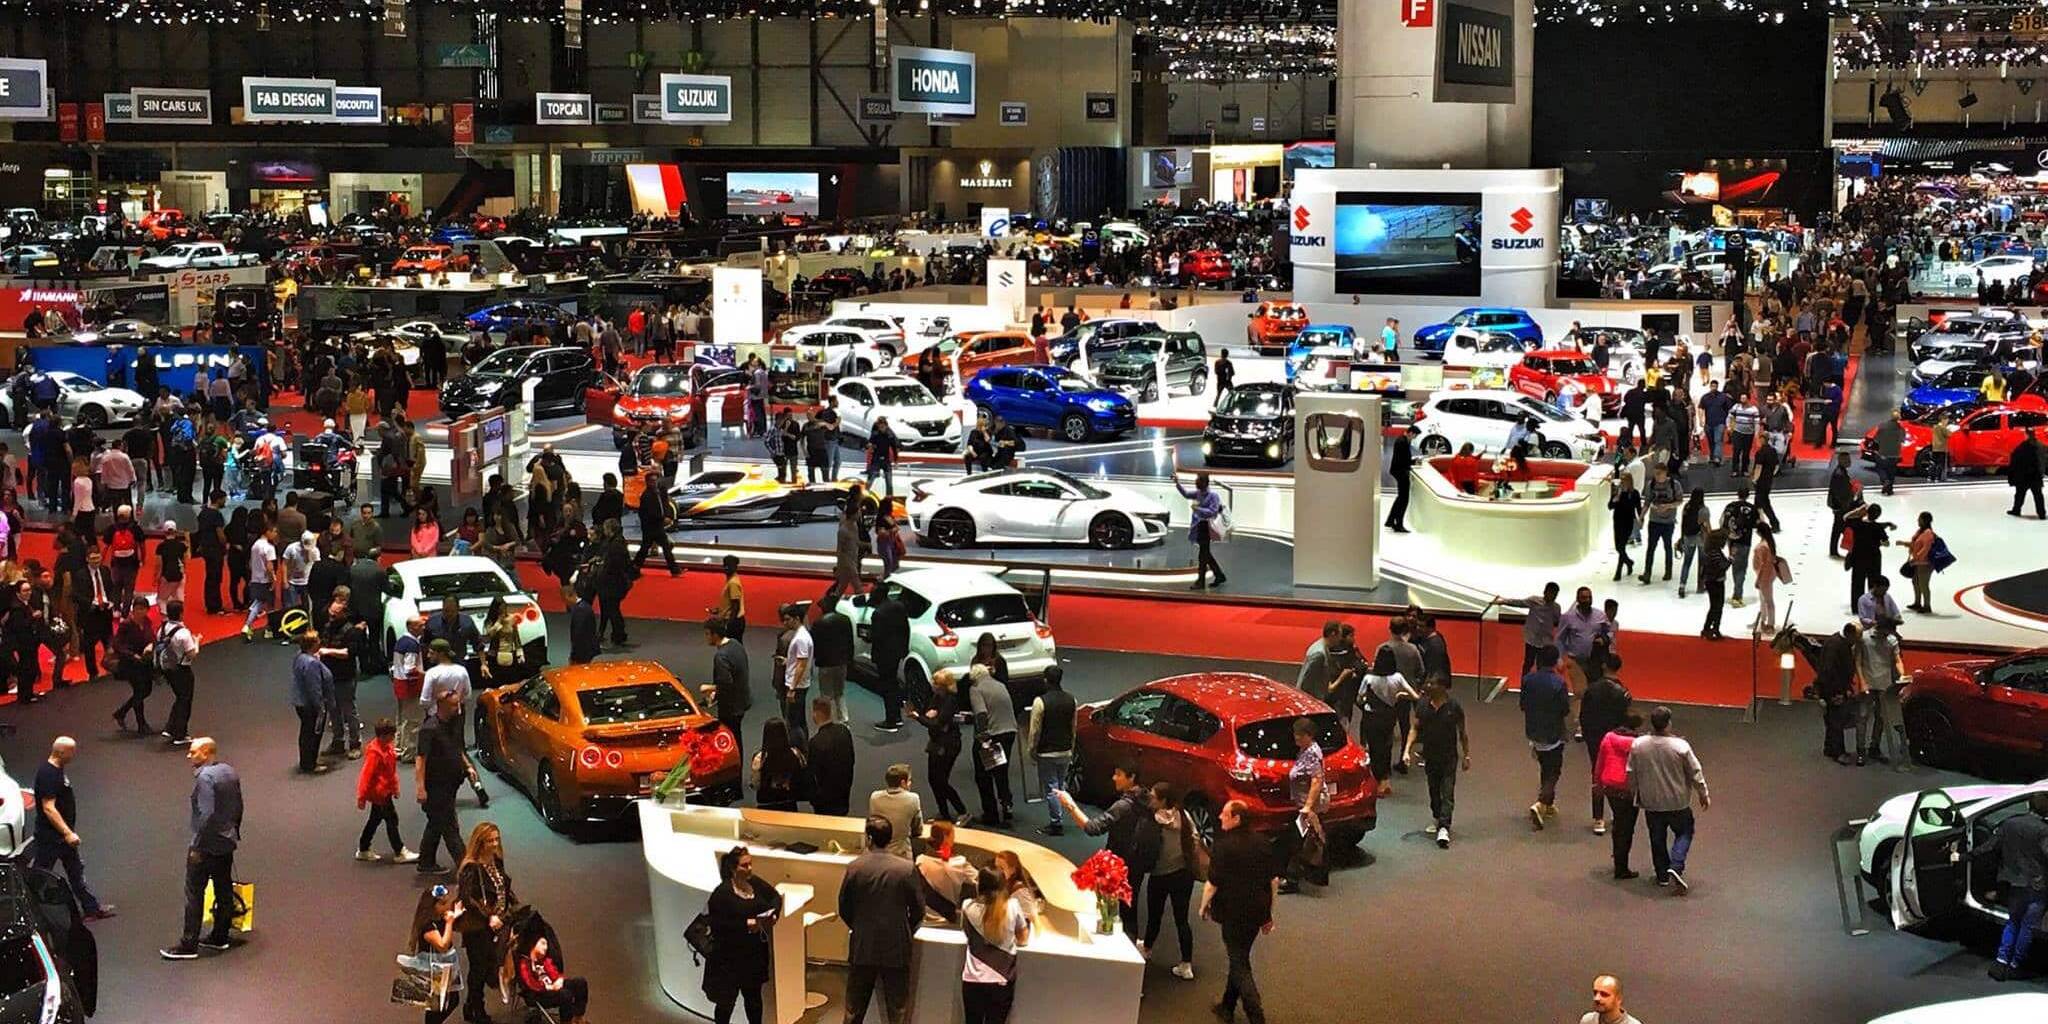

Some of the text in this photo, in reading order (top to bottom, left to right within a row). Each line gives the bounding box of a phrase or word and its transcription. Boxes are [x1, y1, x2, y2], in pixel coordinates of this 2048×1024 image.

[1411, 0, 1425, 19] F
[1458, 22, 1500, 67] NISSAN
[0, 78, 9, 96] E
[911, 68, 959, 94] HONDA
[256, 92, 325, 107] FAB DESIGN
[336, 99, 374, 110] OSCOUT24
[677, 89, 717, 107] SUZUKI
[143, 100, 202, 112] SIN CARS UK
[547, 102, 583, 116] TOPCAR
[960, 179, 1012, 187] MASERATI
[1289, 235, 1326, 247] UZUKI
[1491, 237, 1544, 249] SUZUKI
